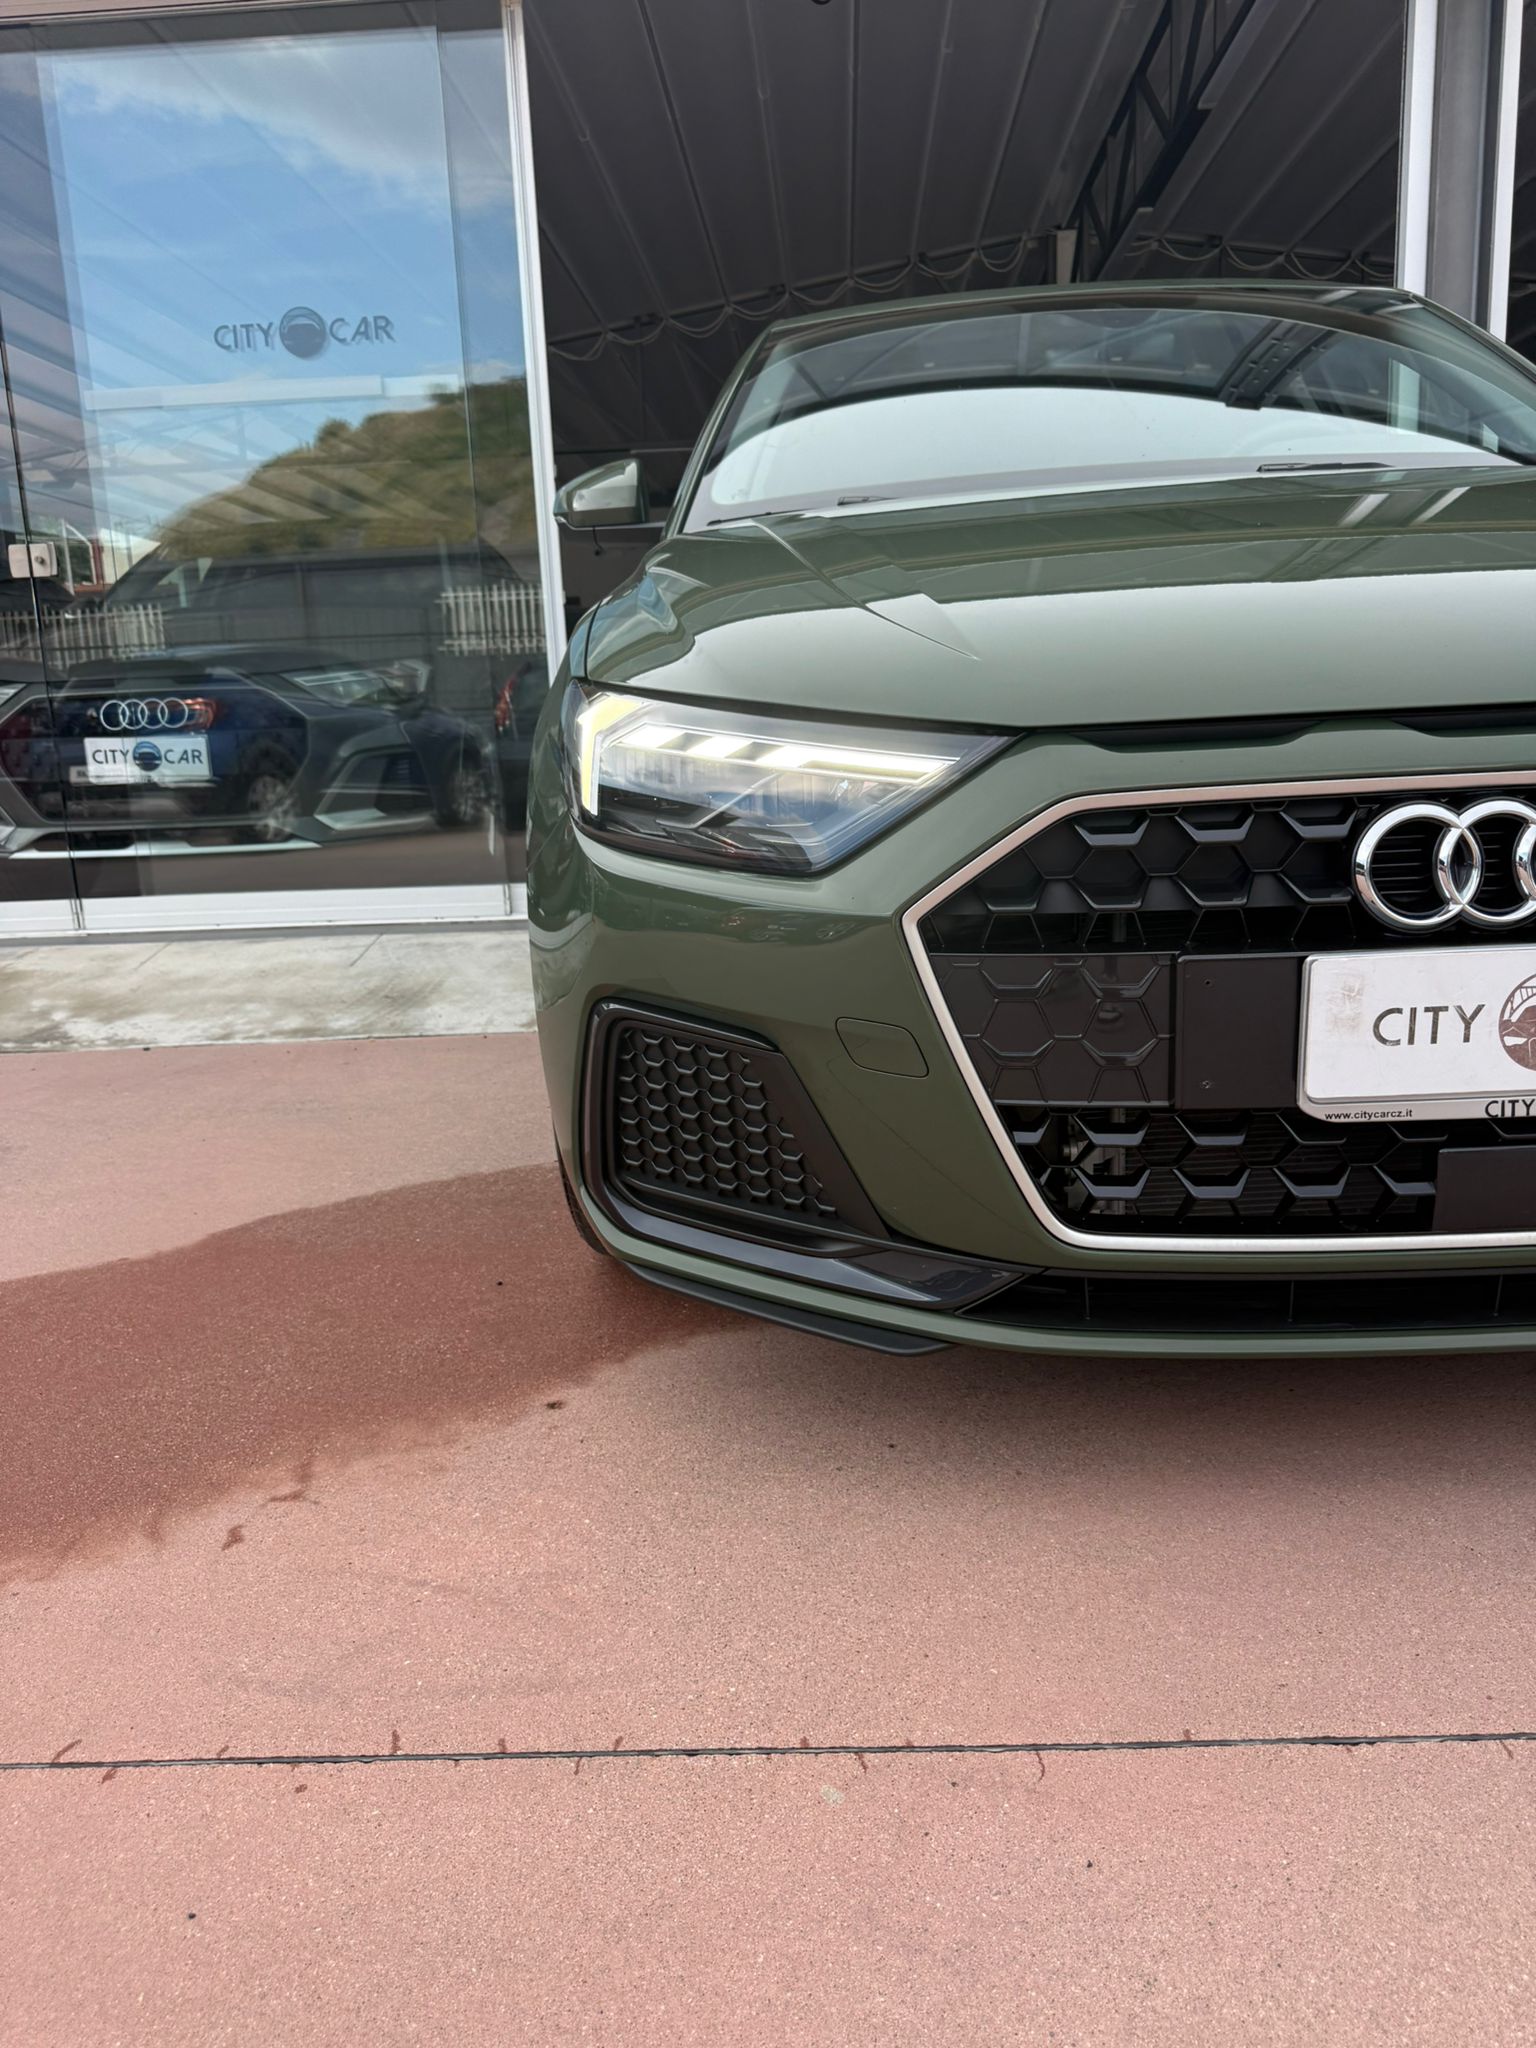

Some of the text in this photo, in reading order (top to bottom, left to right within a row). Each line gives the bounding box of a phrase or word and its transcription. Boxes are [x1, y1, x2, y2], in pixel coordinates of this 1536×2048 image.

[213, 315, 396, 351] CITY CAR
[92, 748, 204, 765] CITY CAR
[1372, 1003, 1486, 1047] CITY
[1324, 1109, 1413, 1121] www.citycarcz.it
[1484, 1098, 1536, 1118] CITY
